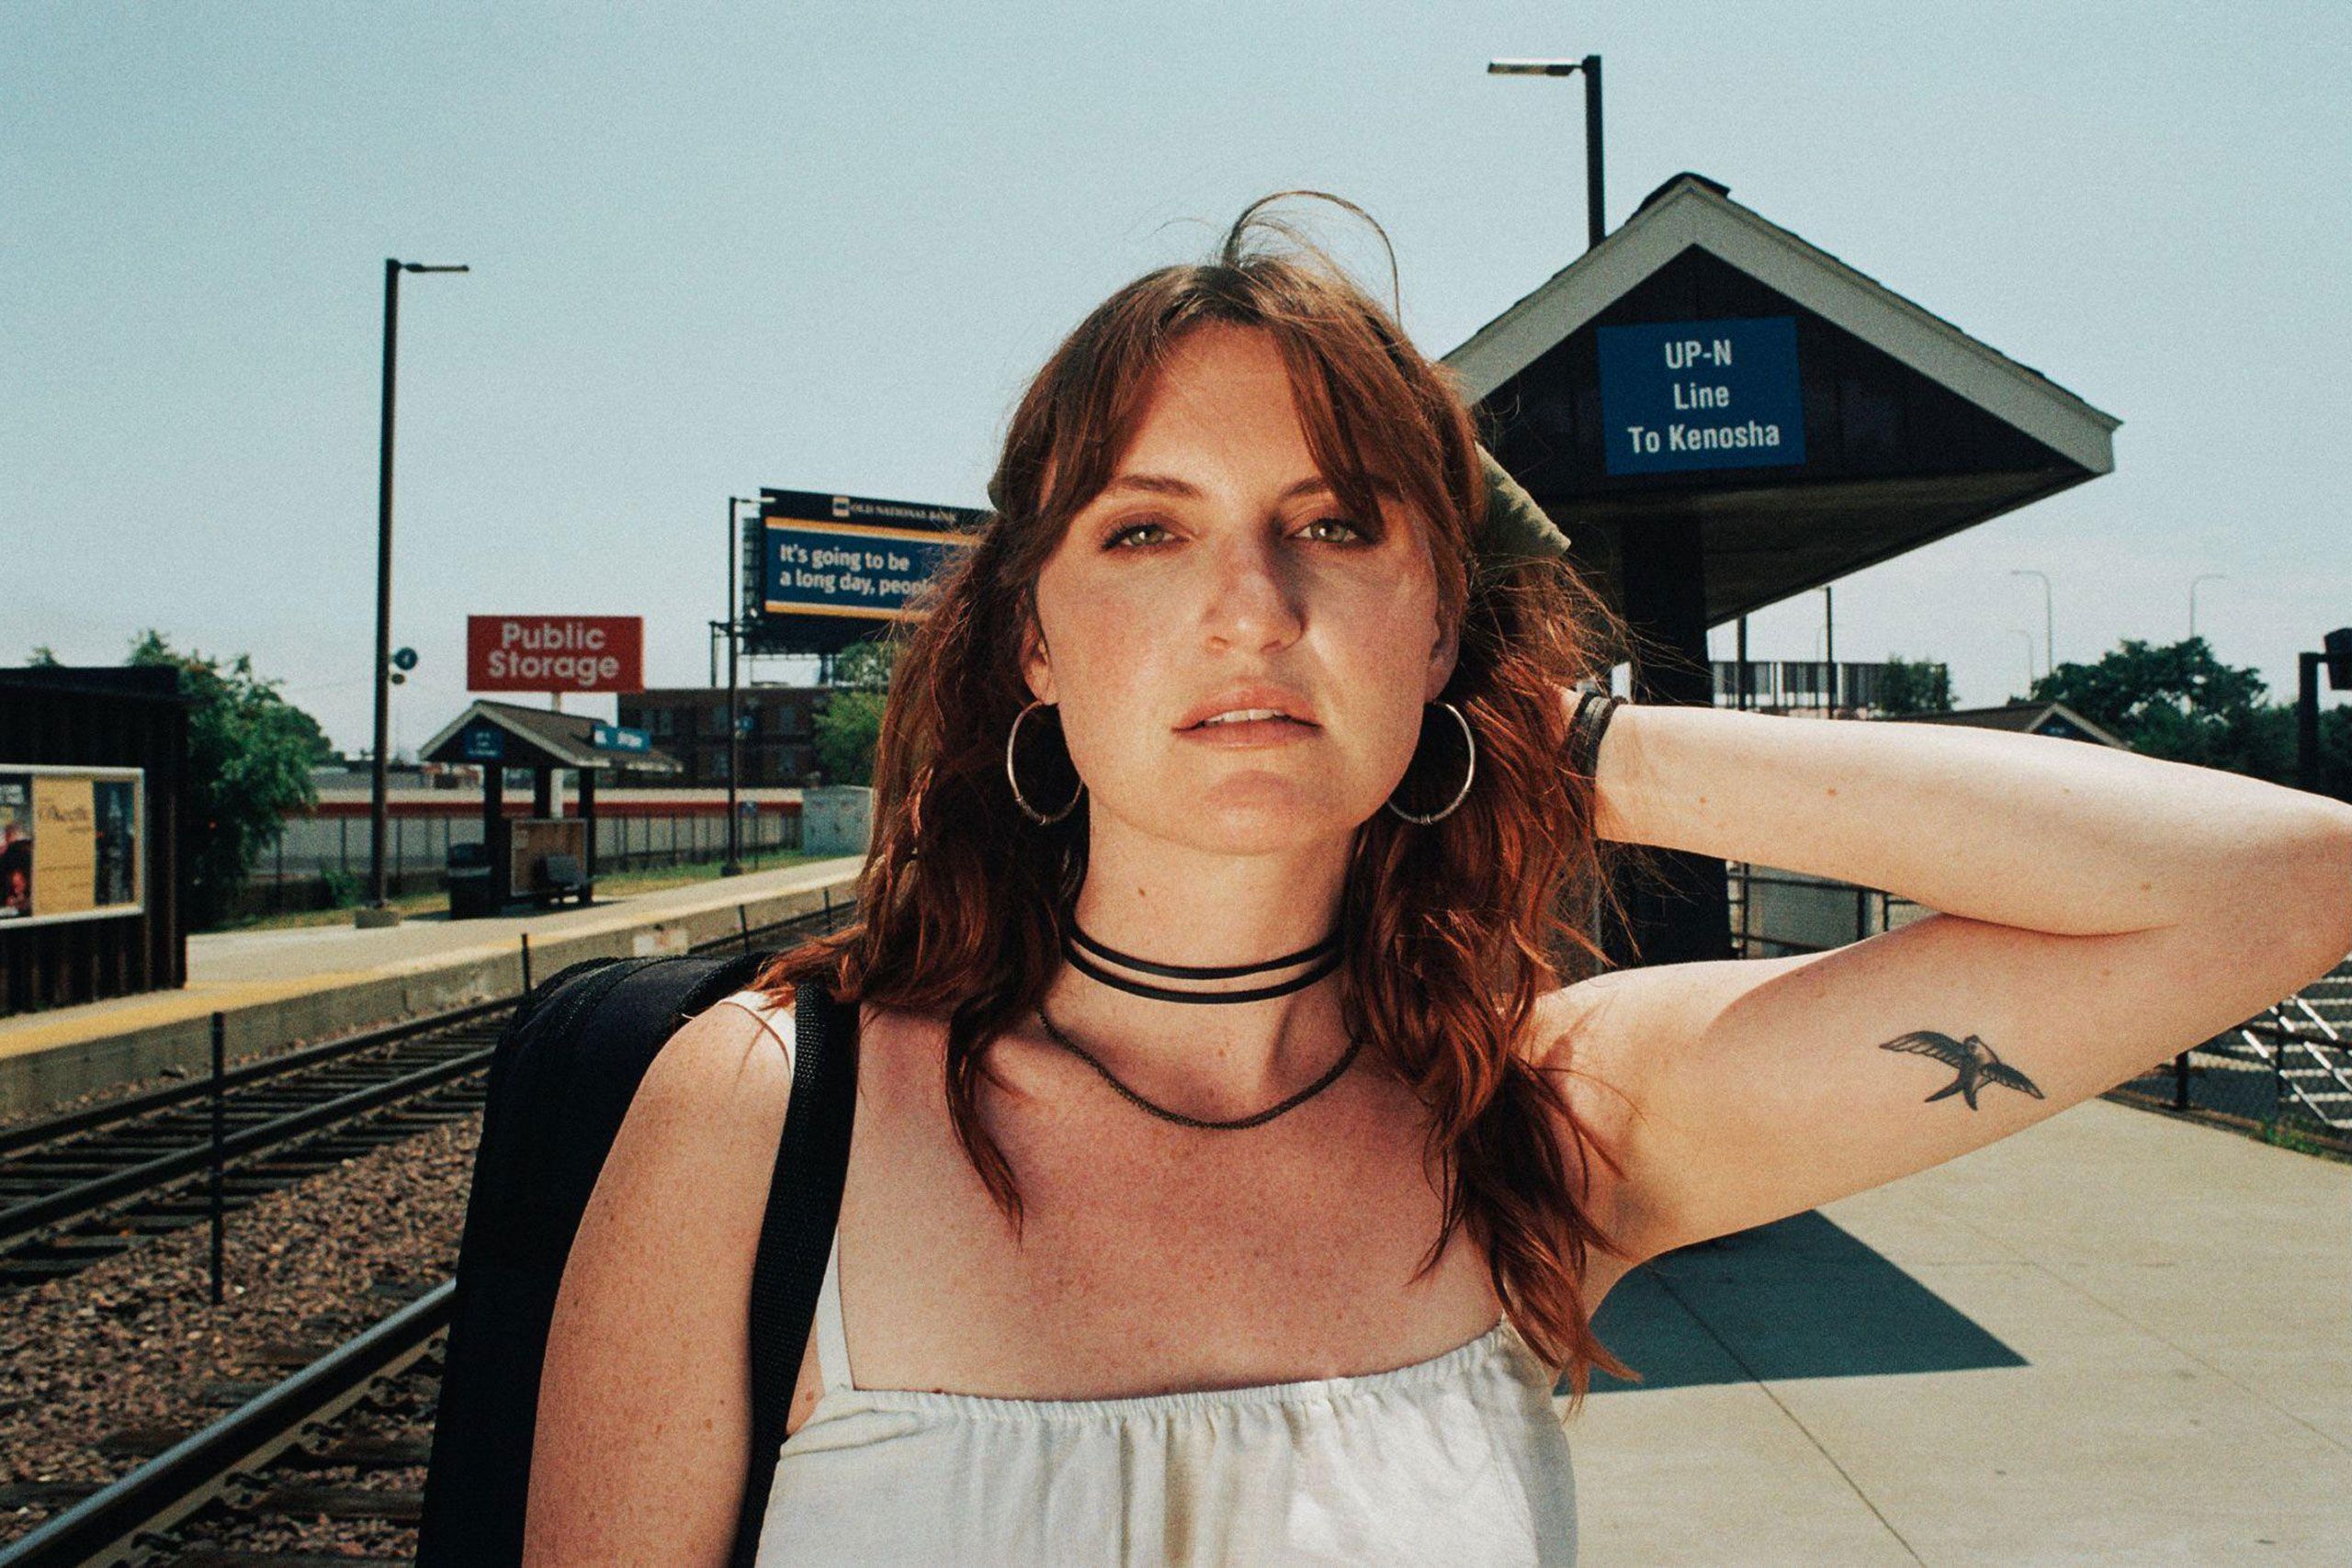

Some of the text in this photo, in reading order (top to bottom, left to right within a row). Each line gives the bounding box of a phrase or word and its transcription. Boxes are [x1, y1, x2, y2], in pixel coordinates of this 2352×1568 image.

[1665, 339, 1732, 369] UP-N
[1674, 382, 1729, 410] Line
[1627, 420, 1780, 454] To Kenosha
[780, 544, 910, 572] It's going to be
[780, 570, 791, 587] a
[796, 569, 836, 593] long
[840, 572, 876, 595] day,
[502, 621, 606, 650] Public
[487, 649, 620, 687] Storage
